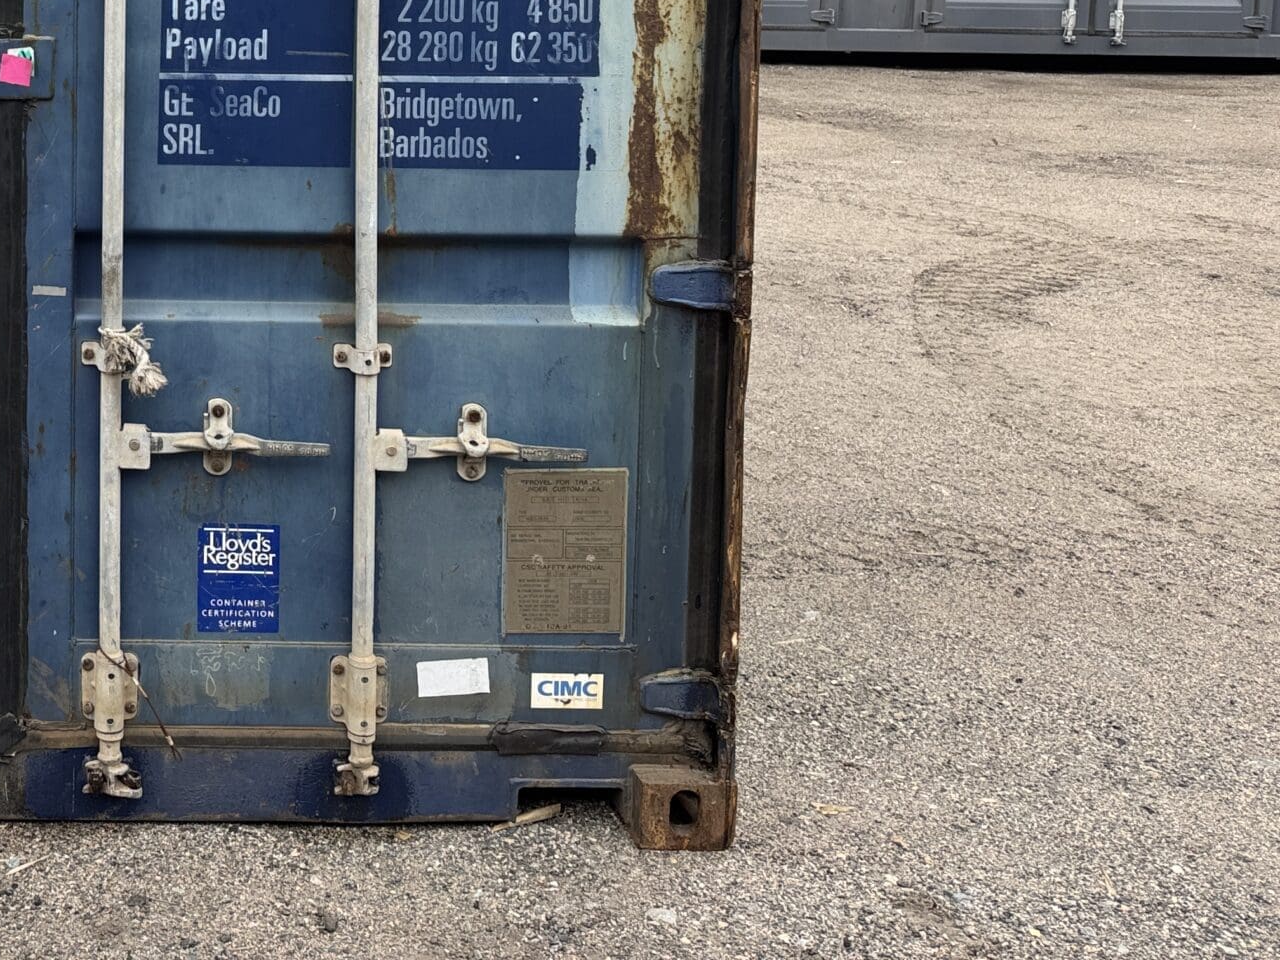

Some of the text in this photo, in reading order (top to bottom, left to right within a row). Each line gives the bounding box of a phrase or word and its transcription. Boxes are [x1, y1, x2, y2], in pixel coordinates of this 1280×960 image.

[165, 27, 268, 67] Payload
[470, 31, 498, 71] kg
[164, 85, 281, 118] GE SeaCo
[381, 87, 522, 123] Bridgetown,
[163, 123, 215, 156] SRL.
[210, 531, 271, 554] Lloyd's
[203, 545, 276, 570] Register
[201, 609, 274, 618] CERTIFICATION
[210, 599, 266, 607] CONTAINER
[218, 620, 257, 628] SCHEME
[537, 680, 598, 697] CIMC
